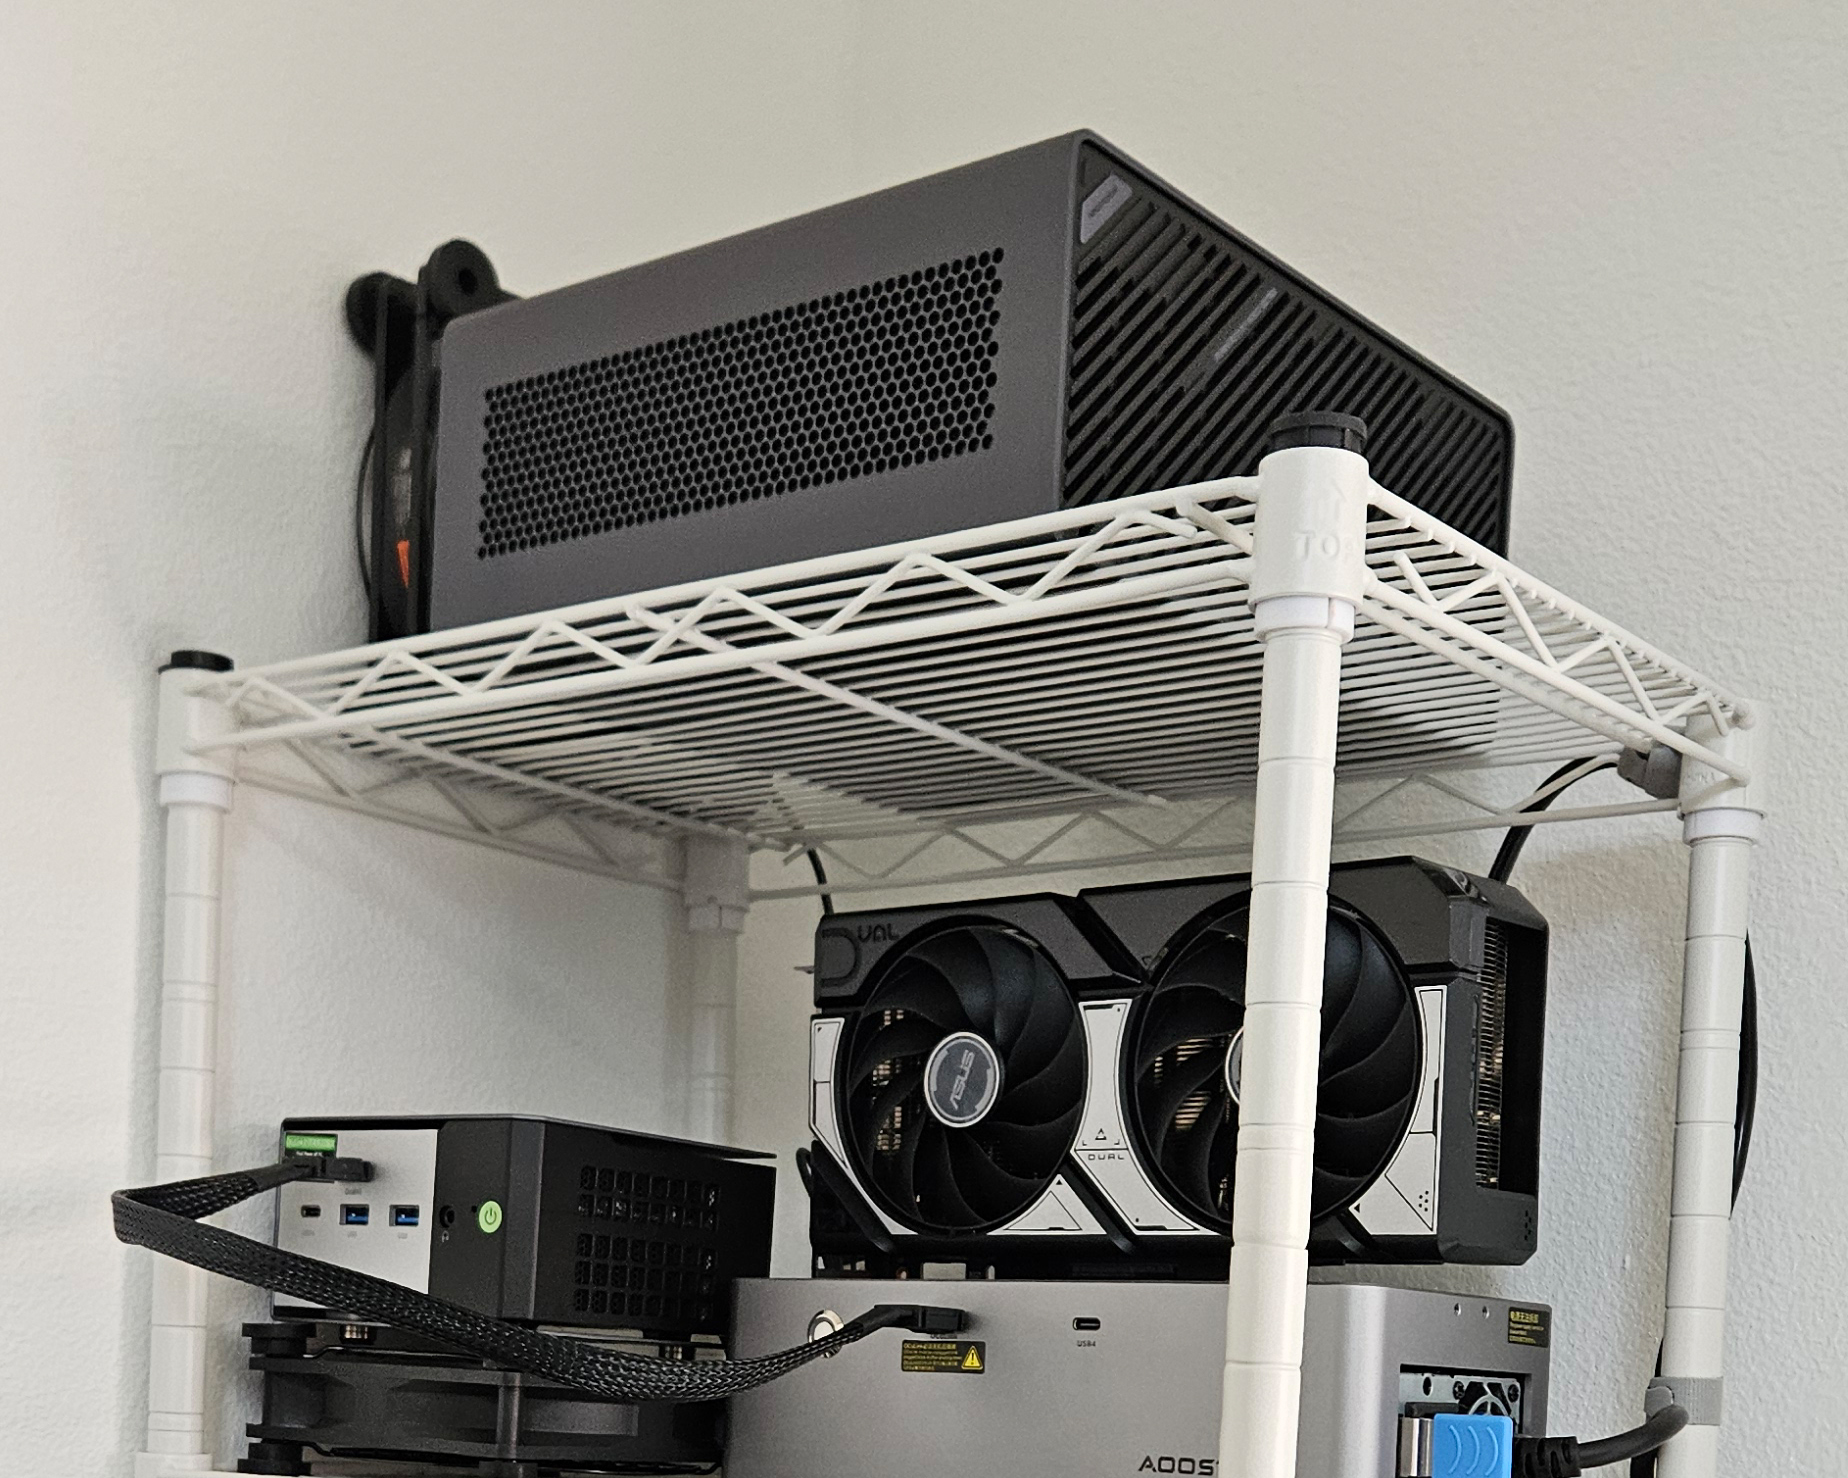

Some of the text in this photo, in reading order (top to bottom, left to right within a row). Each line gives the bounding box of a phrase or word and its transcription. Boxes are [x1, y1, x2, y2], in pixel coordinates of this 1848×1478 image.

[949, 1048, 976, 1111] ASUS
[1087, 1152, 1125, 1161] DUAL
[1138, 1454, 1219, 1476] AOOS
